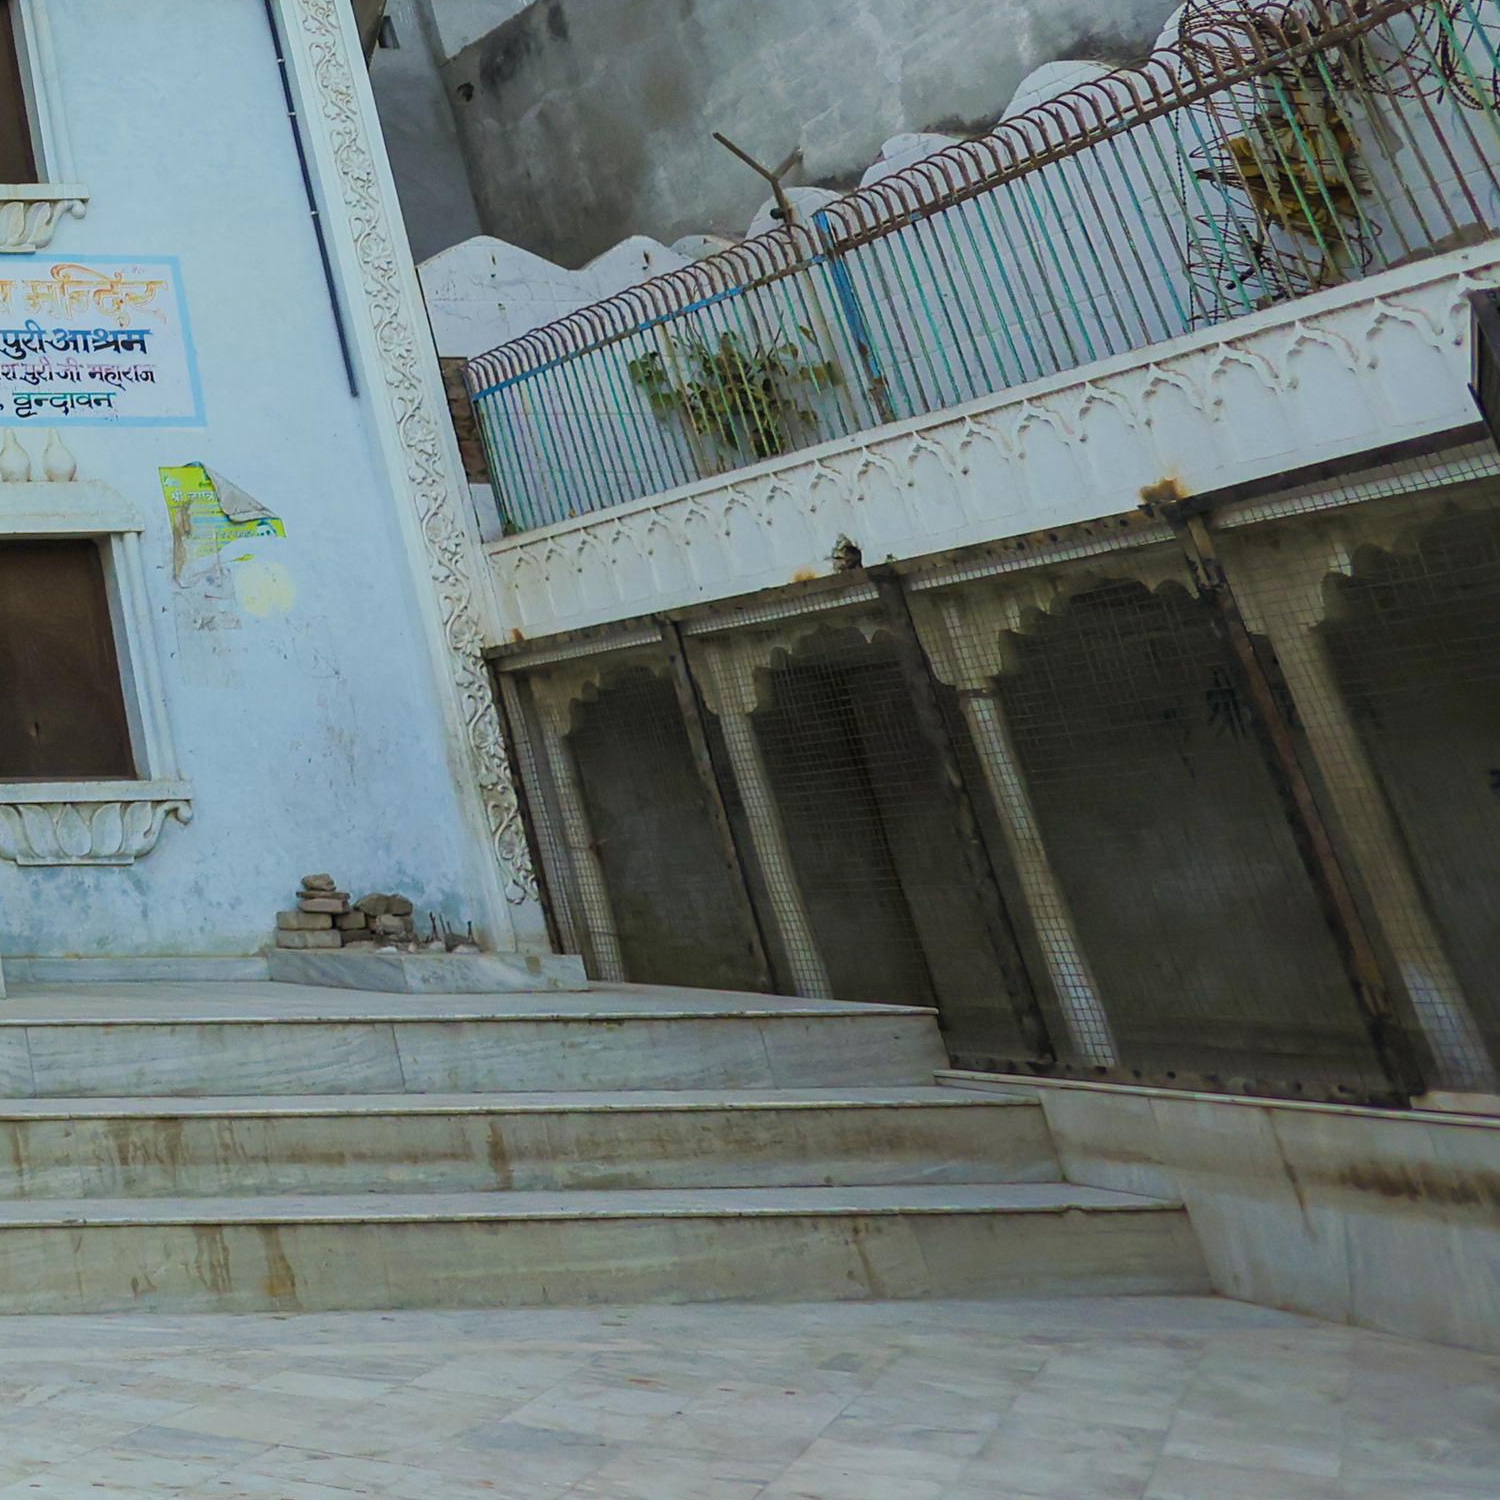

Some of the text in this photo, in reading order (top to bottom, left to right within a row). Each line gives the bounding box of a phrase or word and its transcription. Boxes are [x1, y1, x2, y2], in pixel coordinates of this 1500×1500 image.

[44, 328, 153, 354] आश्रम
[19, 356, 54, 386] पुरी
[56, 356, 84, 382] जी
[87, 363, 156, 391] महाराज
[12, 391, 118, 418] वृन्दावन
